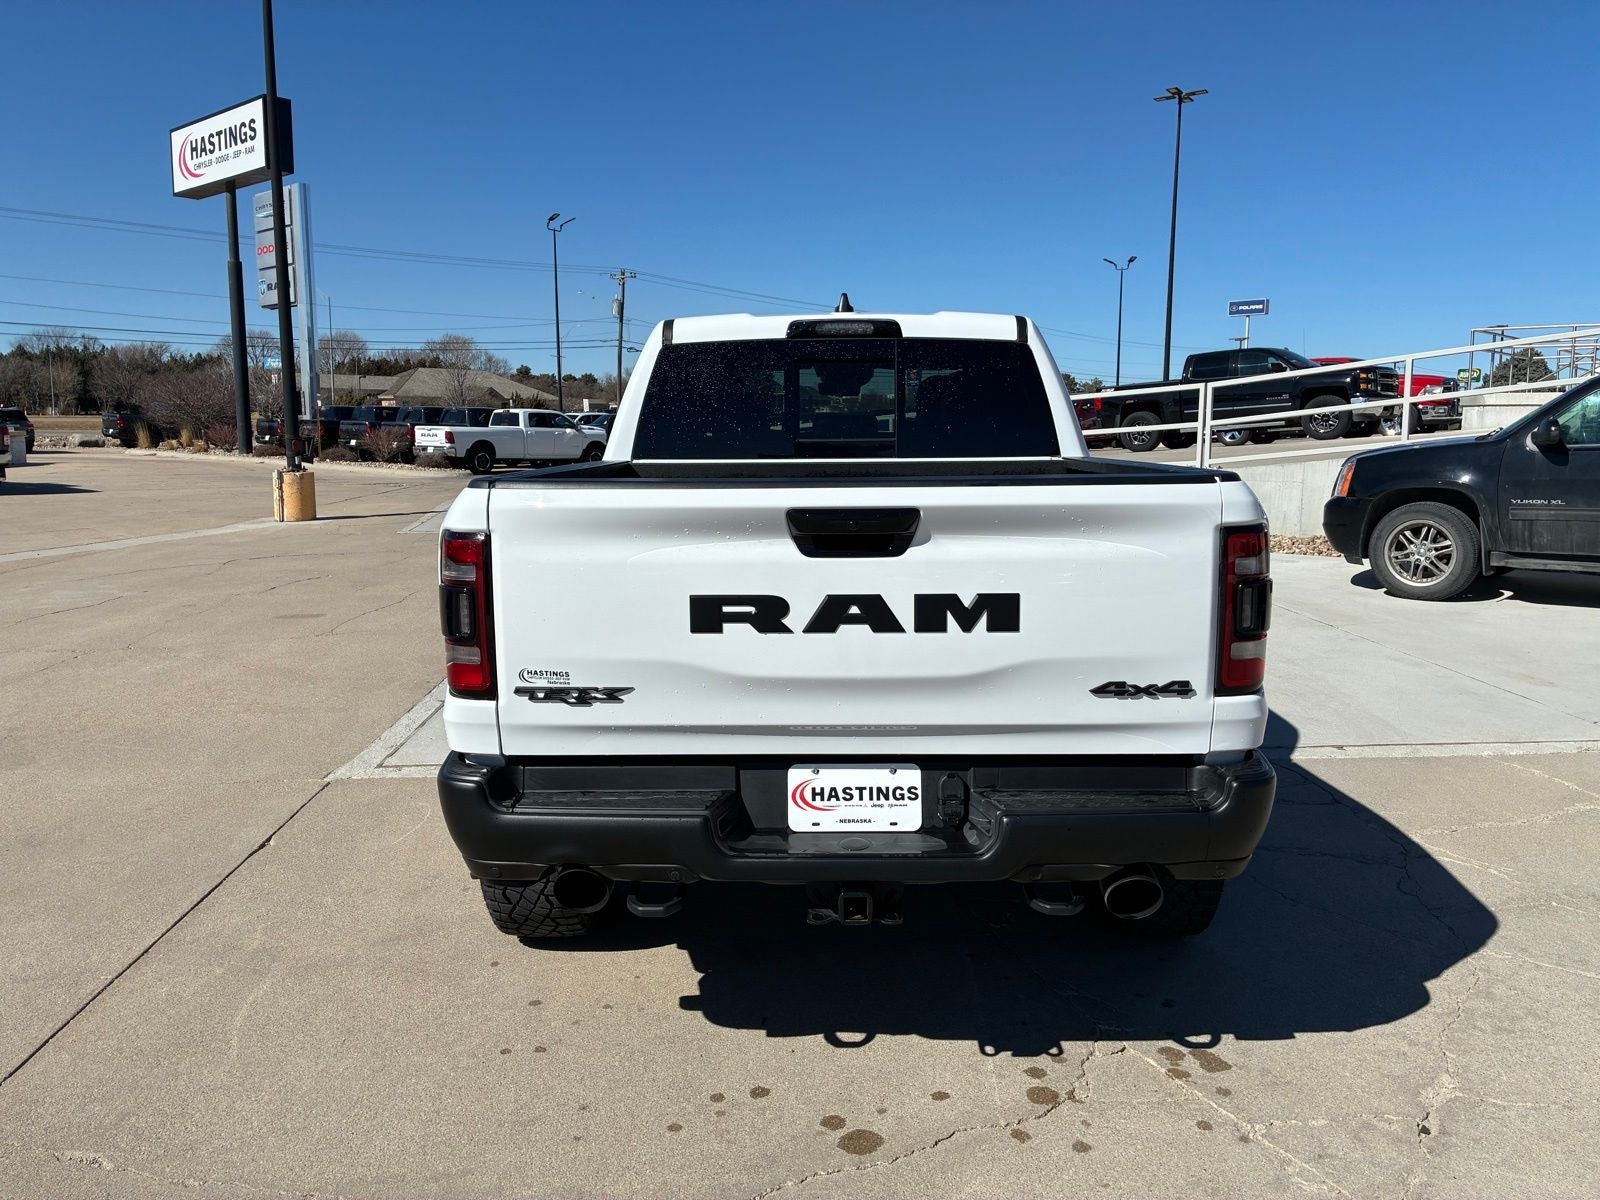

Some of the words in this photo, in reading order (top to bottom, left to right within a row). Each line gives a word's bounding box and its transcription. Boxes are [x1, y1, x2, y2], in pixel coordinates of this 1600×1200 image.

[190, 118, 257, 160] HASTINGS
[690, 593, 1021, 634] RAM
[526, 669, 571, 678] HASTINGS
[513, 686, 636, 707] TRX
[811, 785, 919, 802] HASTINGS
